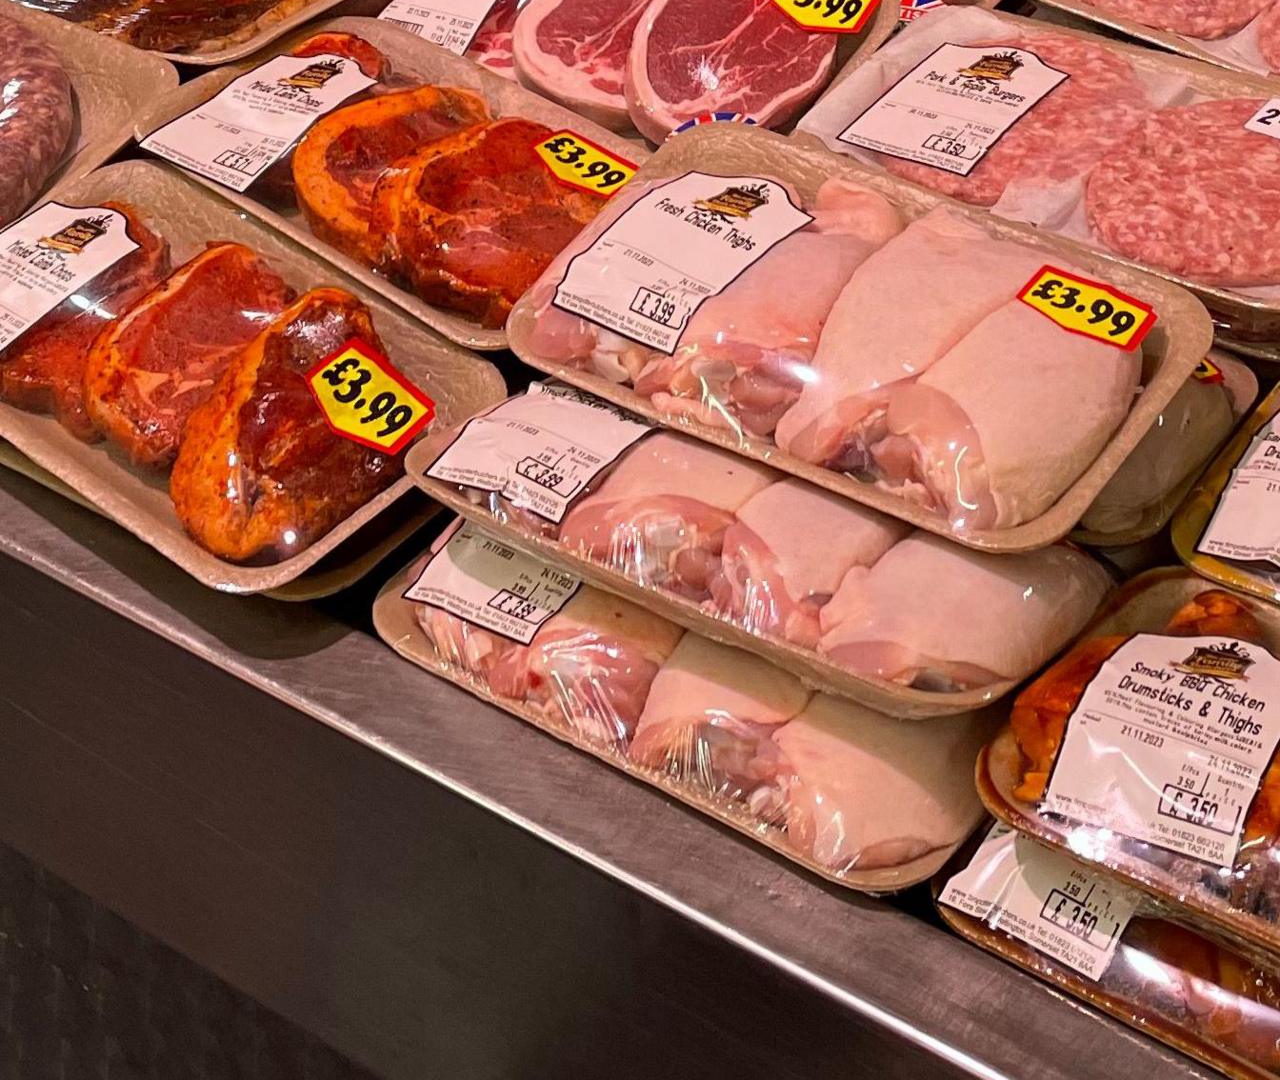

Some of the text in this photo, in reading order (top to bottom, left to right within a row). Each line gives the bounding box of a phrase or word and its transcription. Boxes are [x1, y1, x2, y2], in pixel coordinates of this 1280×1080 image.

[924, 71, 947, 83] Pork
[989, 86, 1026, 103] Burgers
[1257, 108, 1280, 125] 2
[544, 136, 626, 188] £3.99
[654, 197, 757, 252] Fresh Chicken Thighs
[1031, 279, 1136, 338] £3.99
[321, 357, 413, 438] £3.99
[1117, 674, 1193, 710] Drumsticks
[1198, 702, 1212, 717] &
[1220, 706, 1263, 736] Thighs
[1130, 661, 1266, 713] Smoky BBQ Chicken
